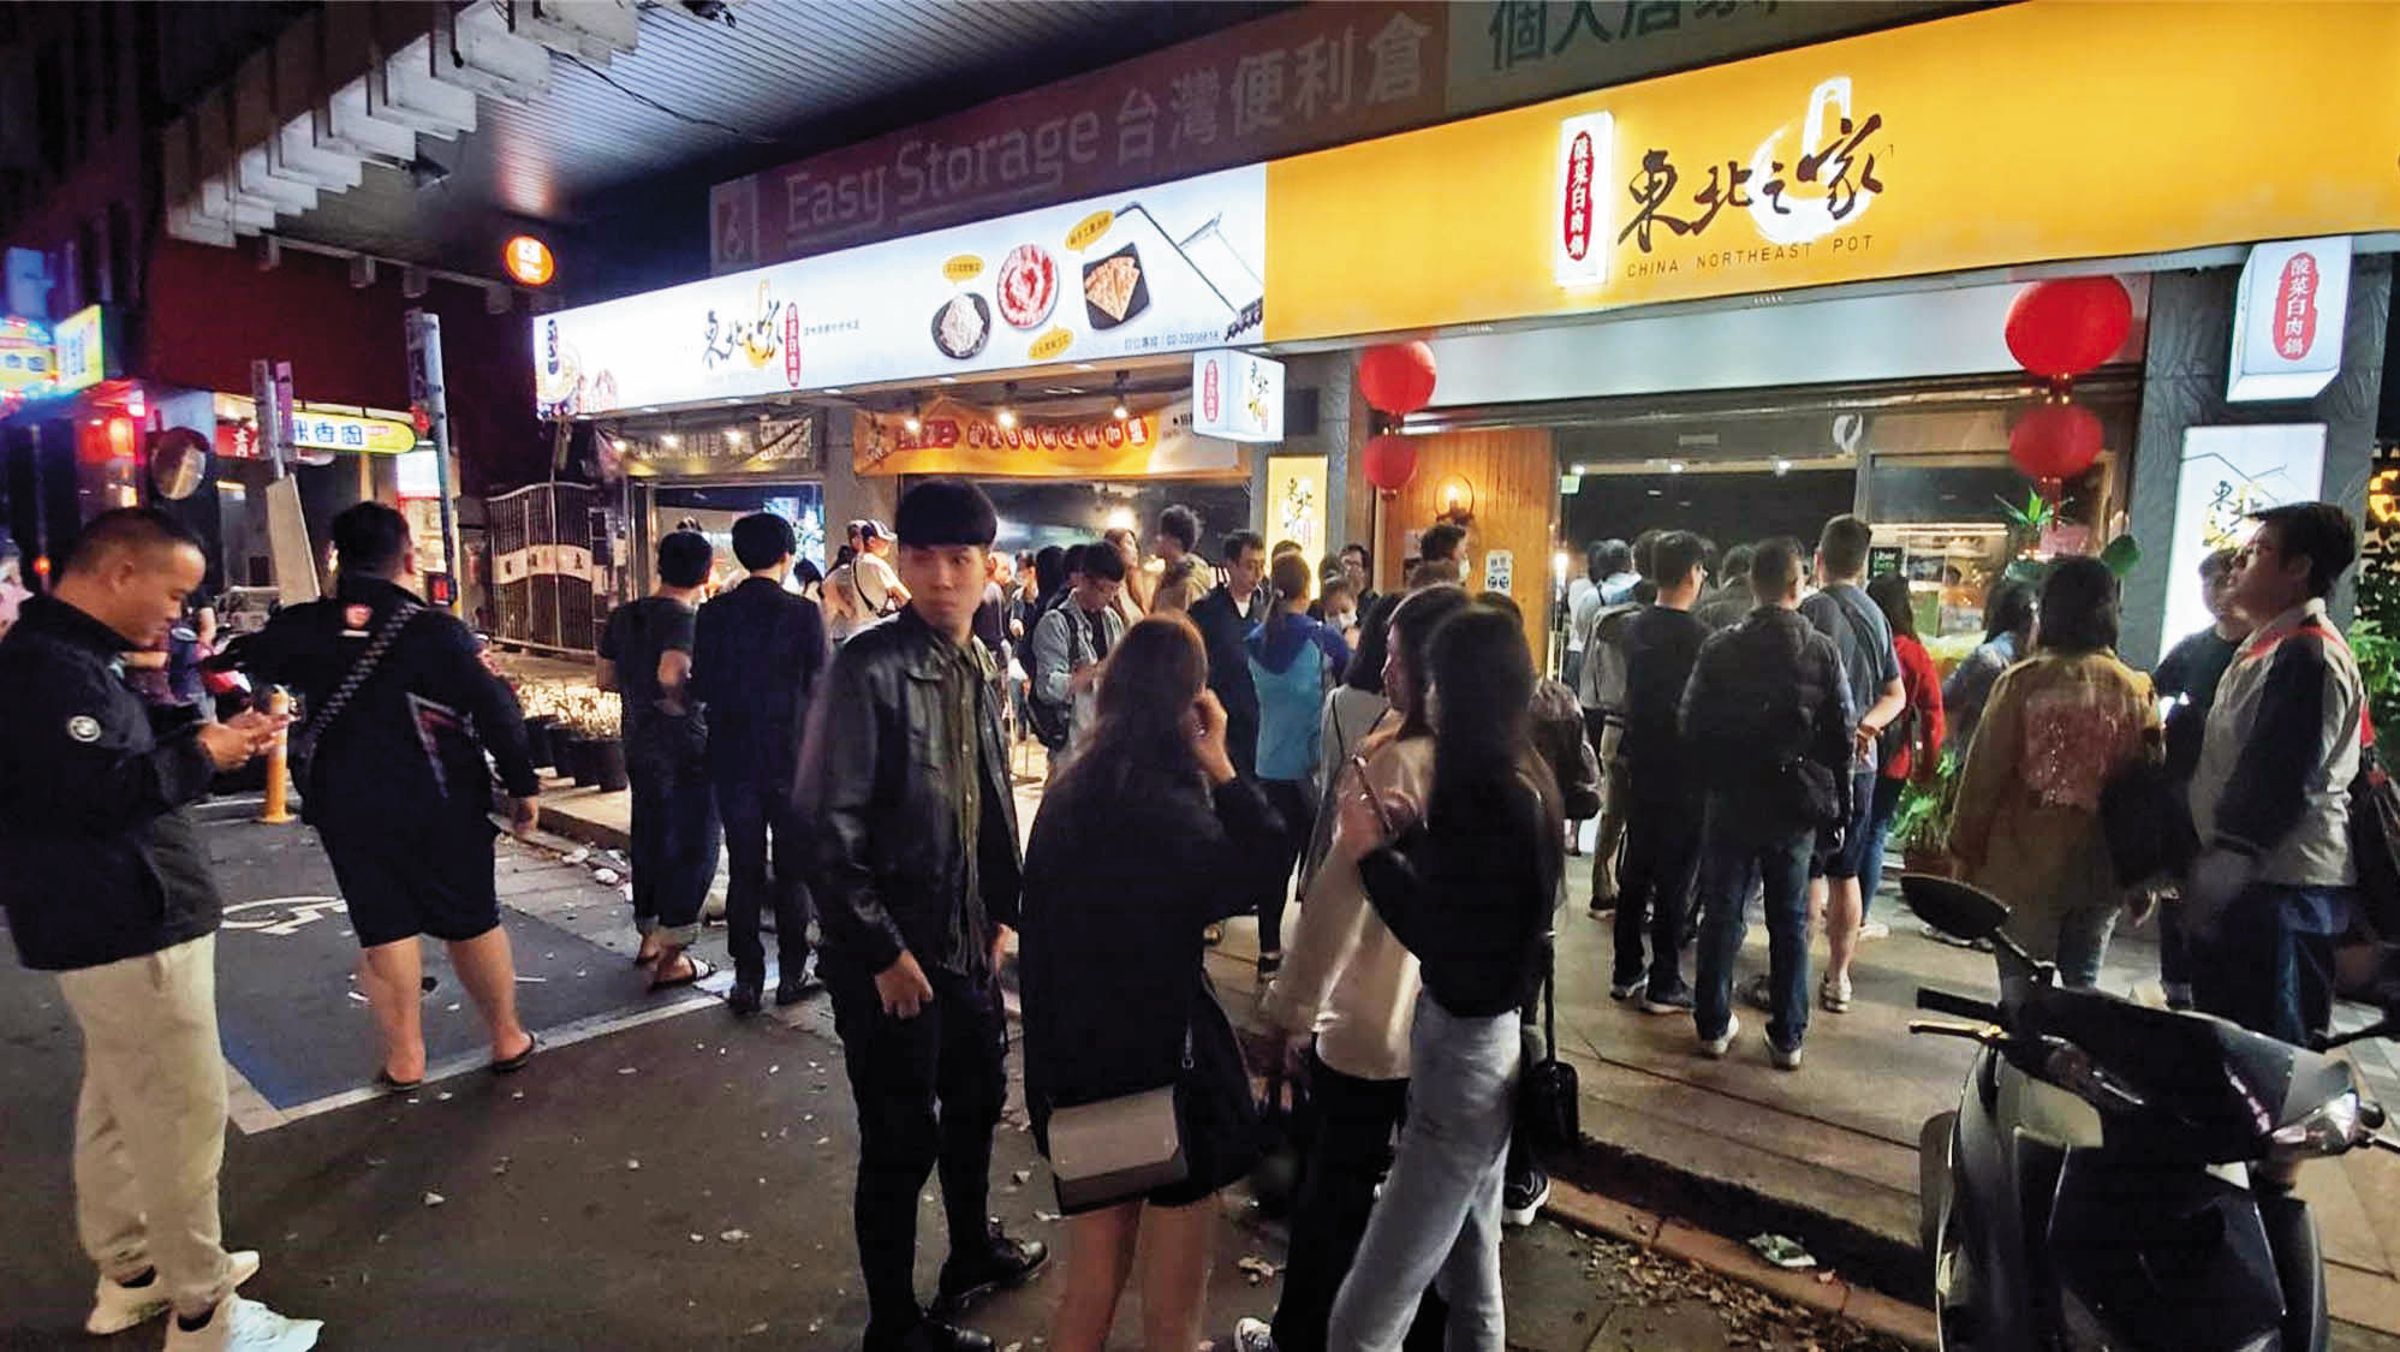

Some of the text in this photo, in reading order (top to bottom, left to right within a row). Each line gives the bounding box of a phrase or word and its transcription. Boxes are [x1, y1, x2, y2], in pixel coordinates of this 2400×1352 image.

[1116, 10, 1432, 167] 台灣便利倉
[786, 110, 1100, 234] Easy Storage
[1617, 114, 1883, 253] 東北之家
[1627, 235, 1874, 279] CHINA NORTHEAST POT
[2283, 257, 2314, 356] 酸菜白肉鍋
